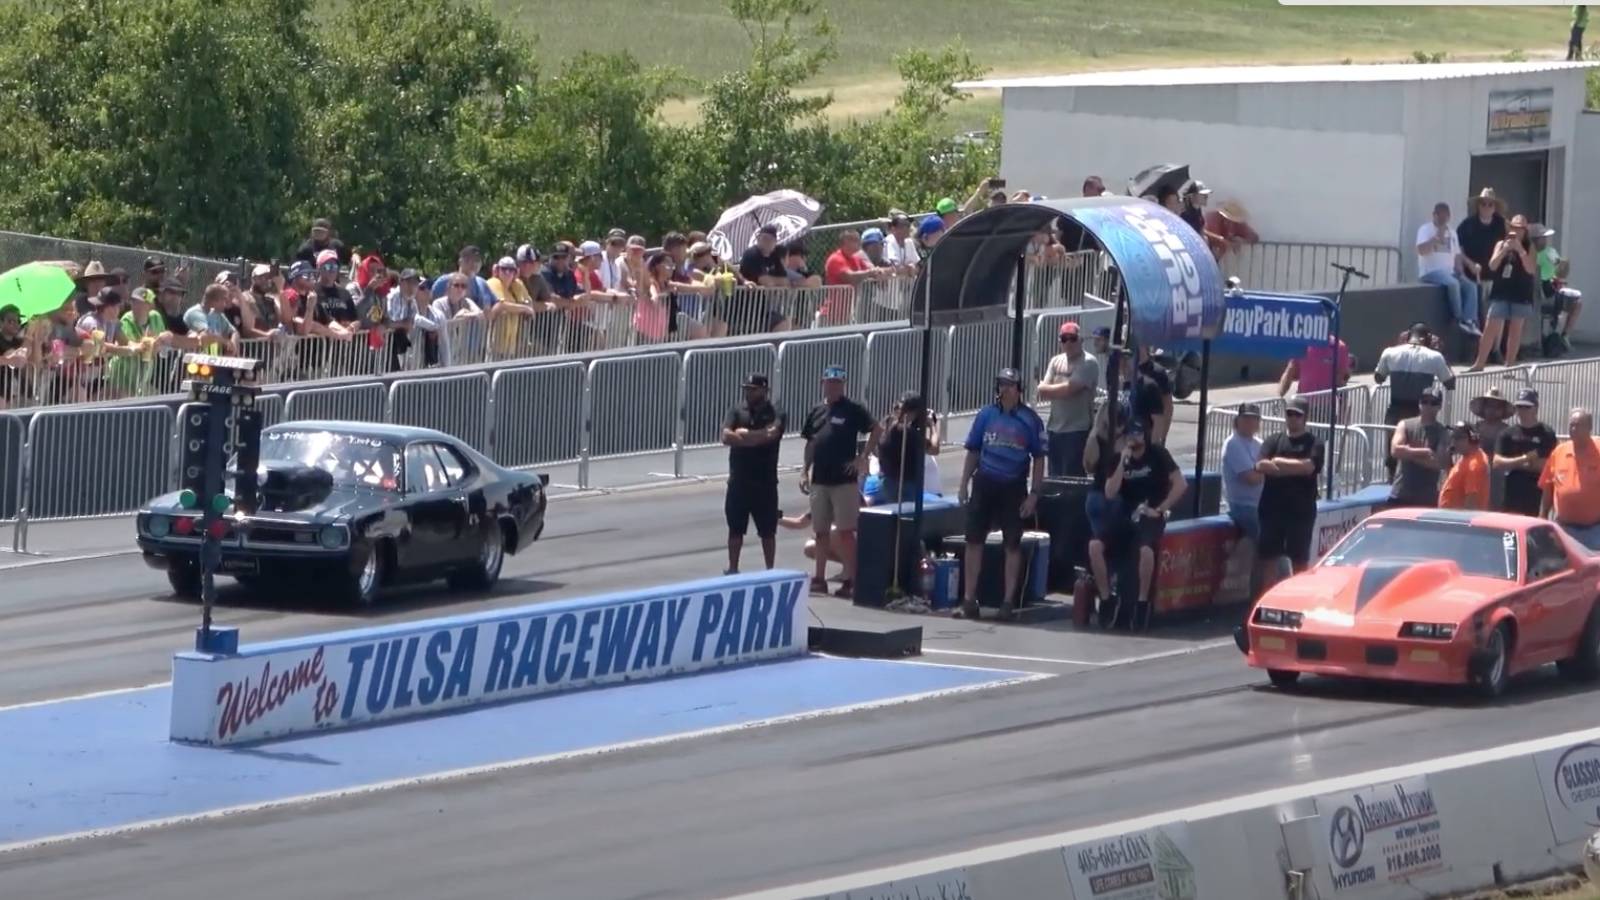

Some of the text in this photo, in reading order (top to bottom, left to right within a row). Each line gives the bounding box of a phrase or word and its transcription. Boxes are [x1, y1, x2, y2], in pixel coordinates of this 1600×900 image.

[1124, 213, 1188, 325] BUD
[201, 384, 232, 394] STAGE
[216, 645, 340, 739] Welcome to
[340, 580, 805, 720] TULSA RACEWAY PARK
[1333, 866, 1376, 890] HYUNDAI
